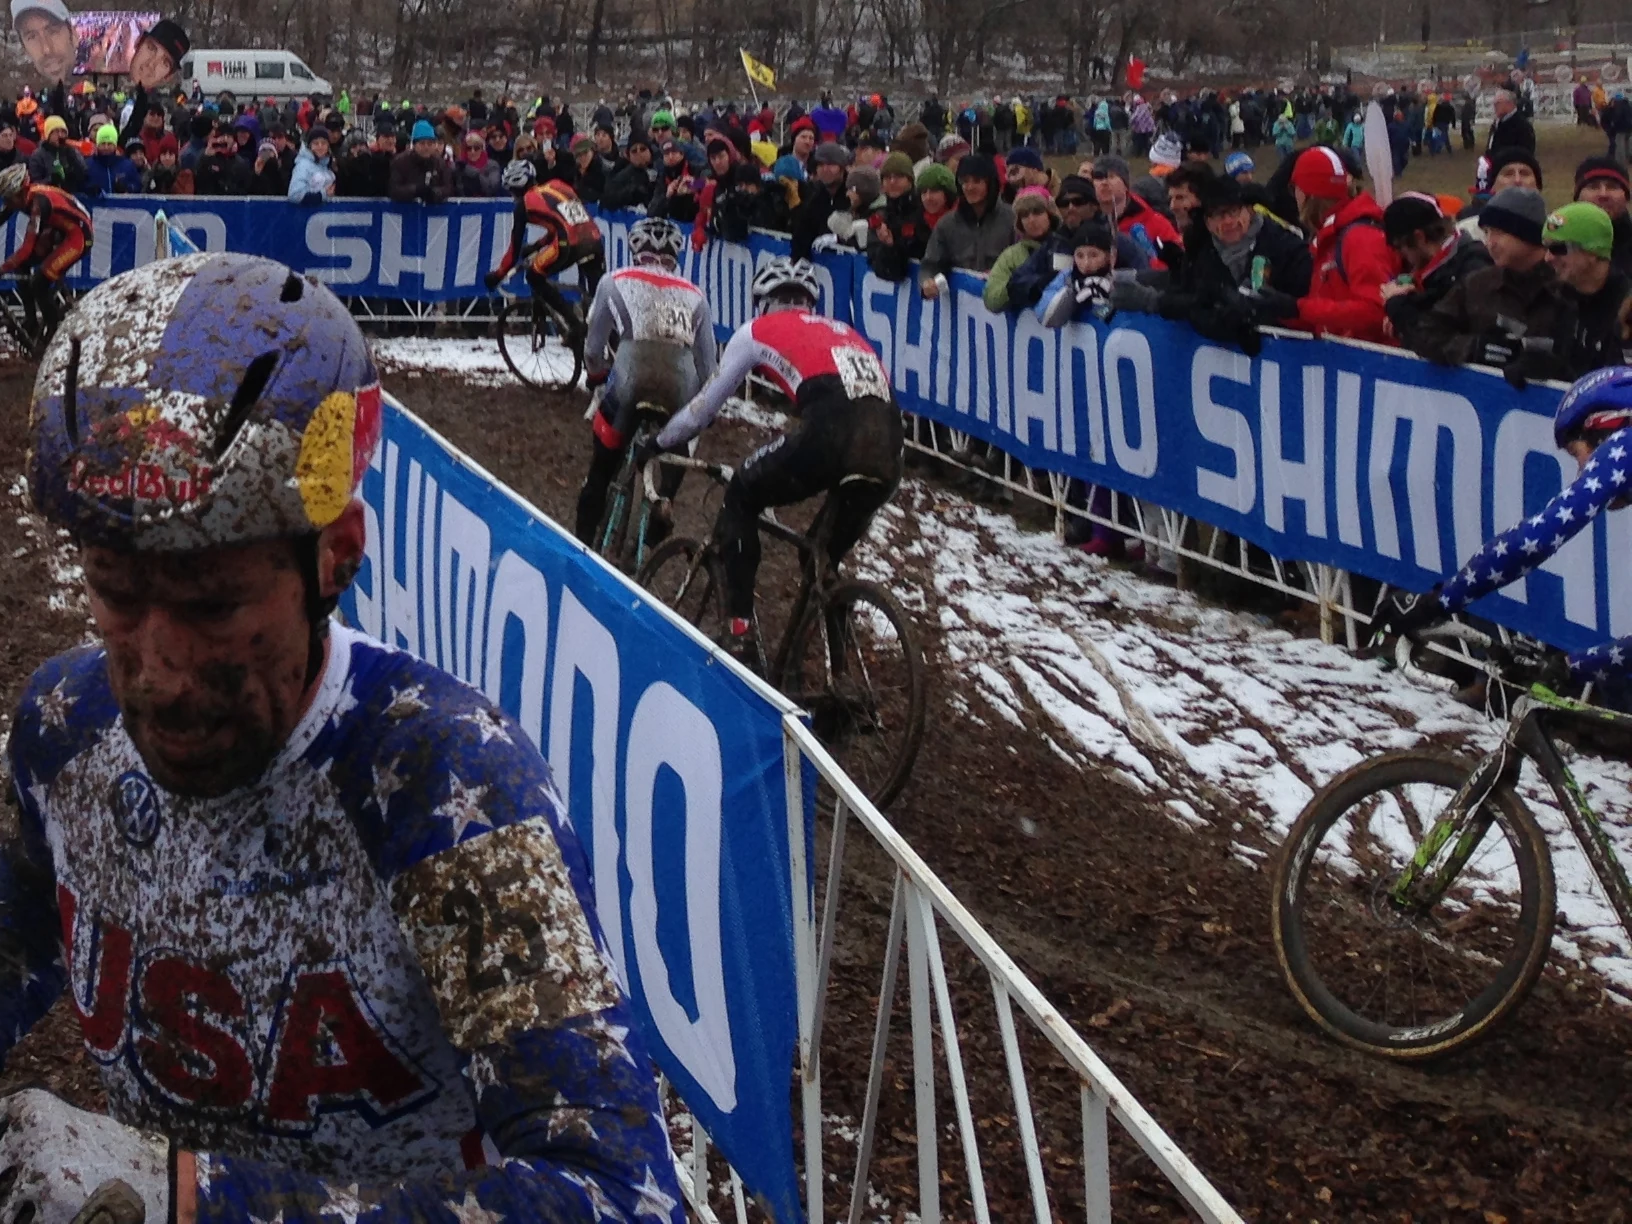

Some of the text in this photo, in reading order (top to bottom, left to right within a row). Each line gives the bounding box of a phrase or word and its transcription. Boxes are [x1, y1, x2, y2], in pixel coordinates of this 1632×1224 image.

[862, 271, 1159, 479] SHIMANO
[353, 437, 737, 1114] SHIMANO
[57, 882, 441, 1138] USA
